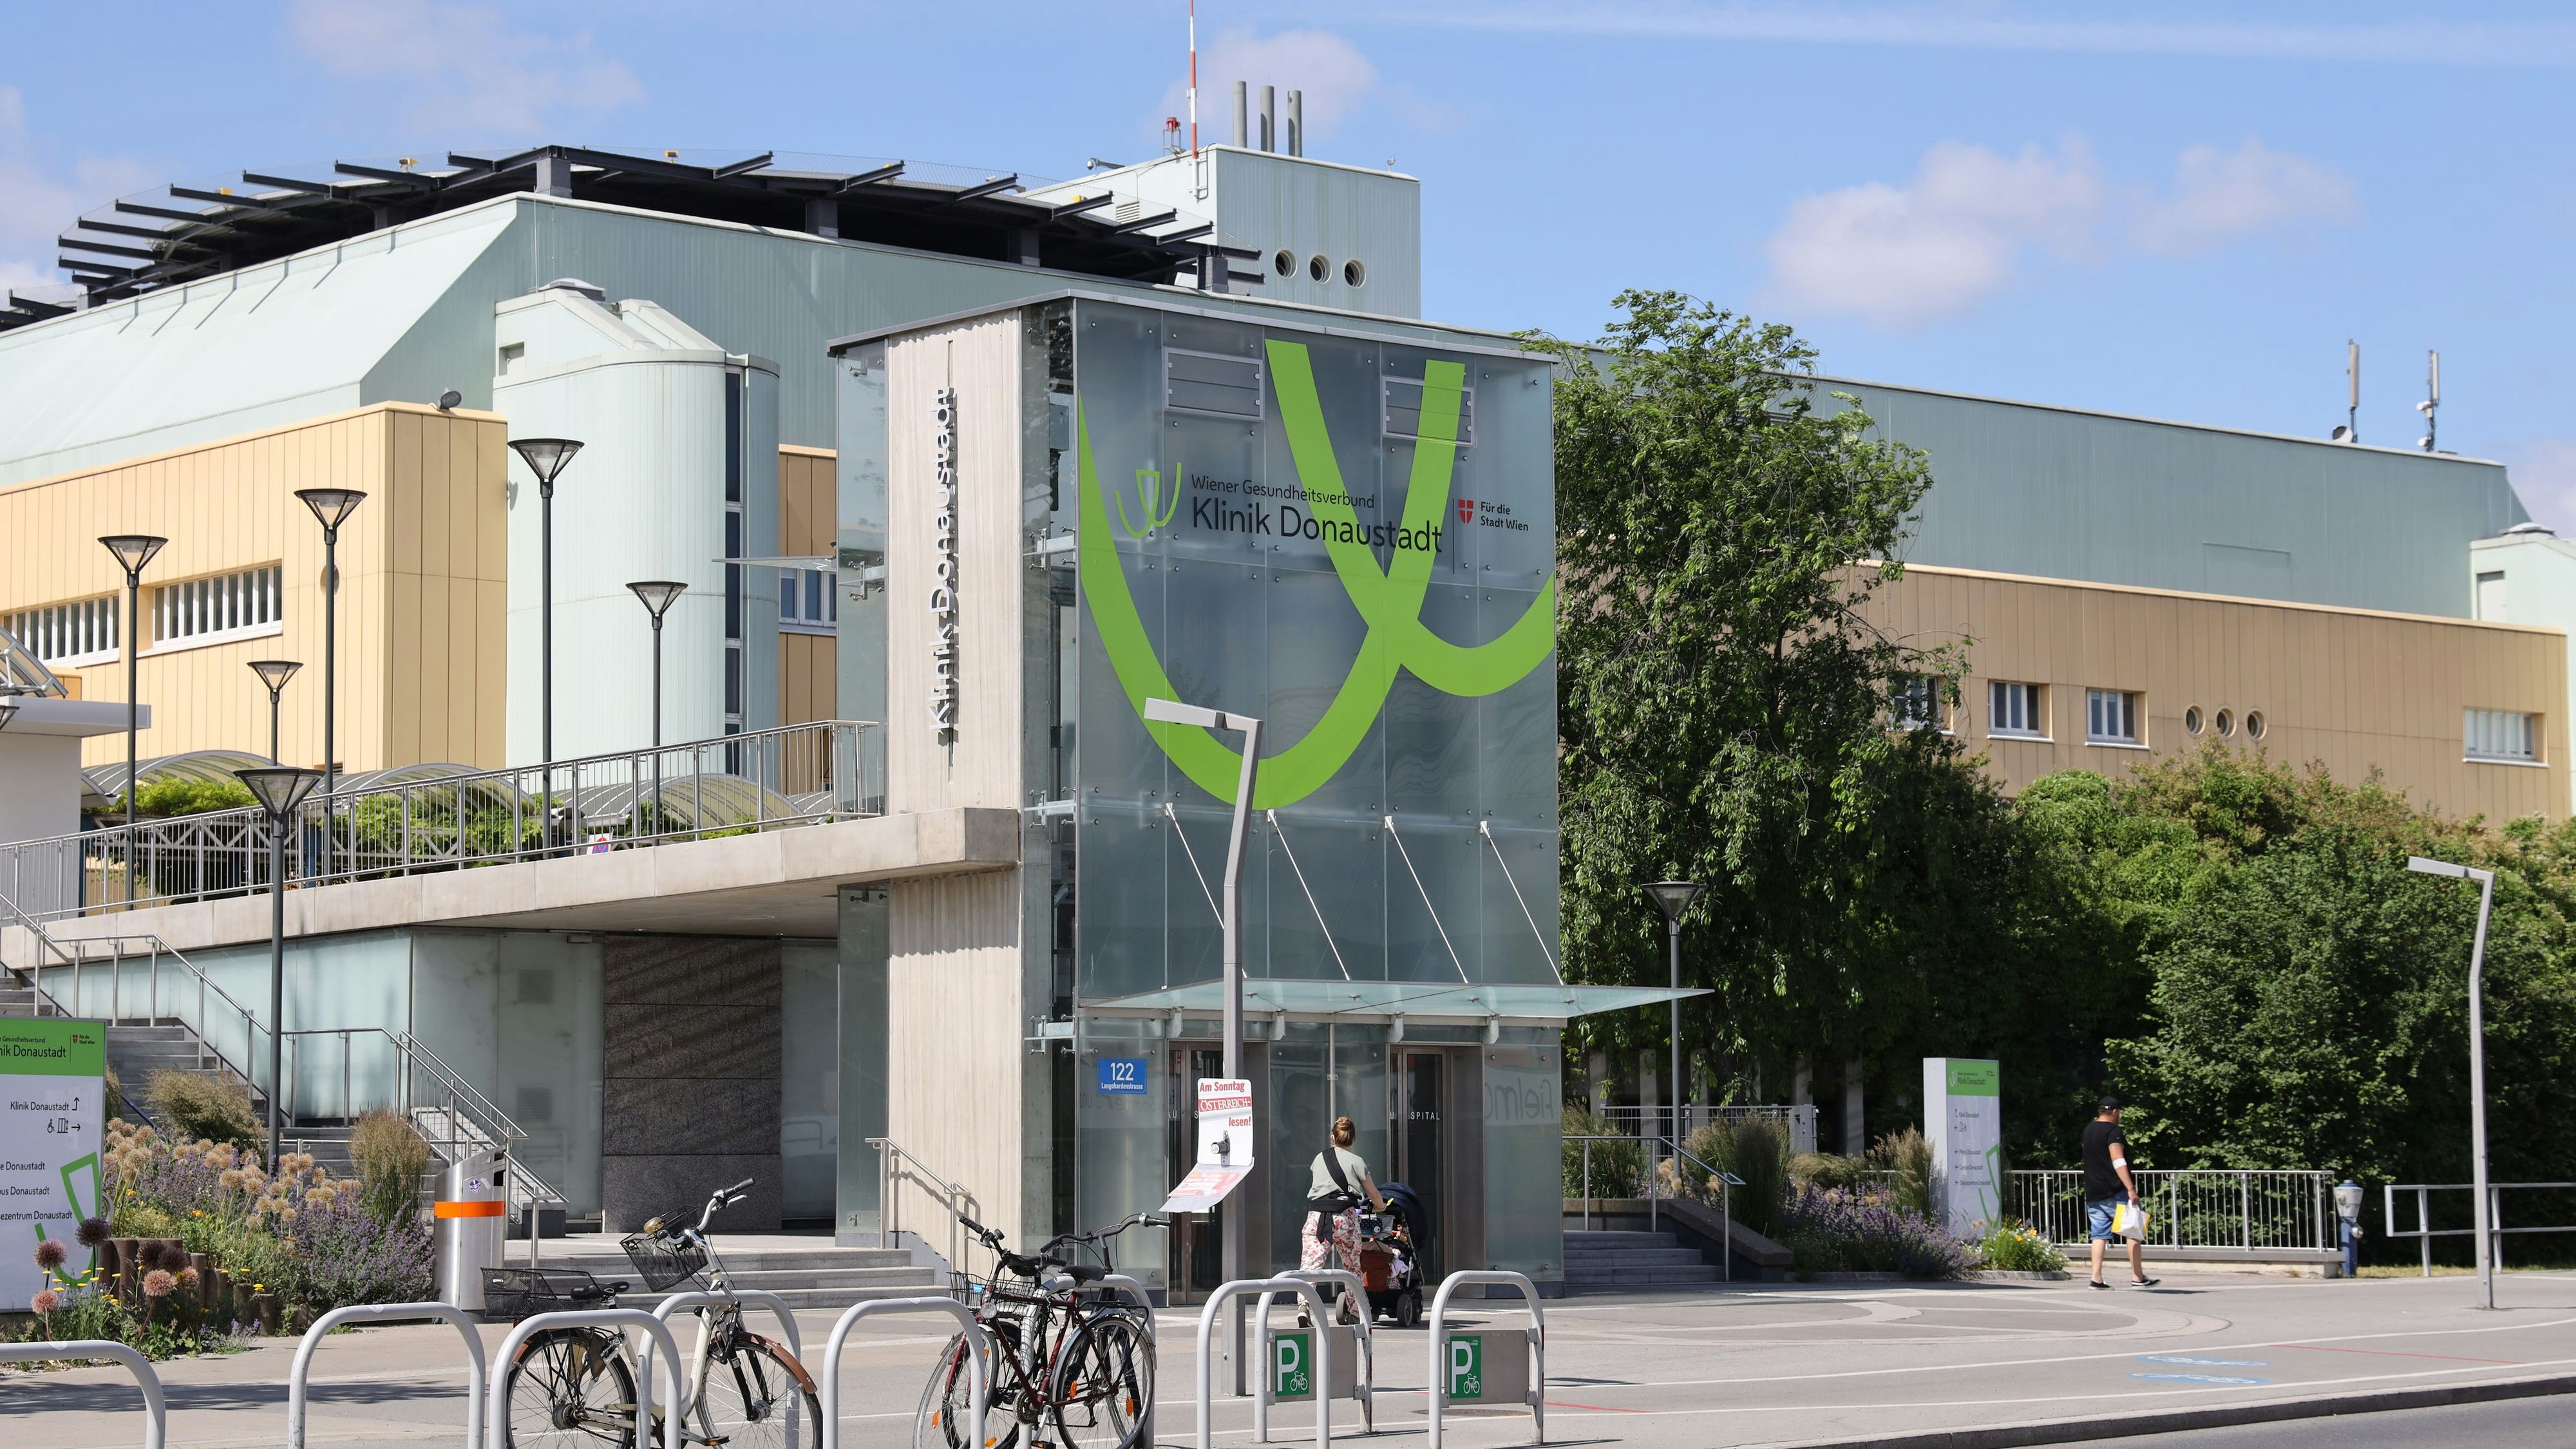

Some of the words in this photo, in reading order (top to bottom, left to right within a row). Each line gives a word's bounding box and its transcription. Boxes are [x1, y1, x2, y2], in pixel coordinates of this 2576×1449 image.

[1191, 473, 1238, 494] Wiener
[1242, 478, 1375, 509] Gesundheitsverbund
[929, 386, 955, 614] Donaustadt
[1481, 500, 1495, 514] Für
[1497, 503, 1511, 515] die
[1193, 497, 1271, 535] Klinik
[1280, 505, 1443, 553] Donaustadt
[1481, 515, 1504, 529] Stadt
[1506, 519, 1529, 532] Wien
[928, 623, 954, 732] Klinik
[14, 1045, 66, 1058] Donaustadt
[1110, 1062, 1134, 1081] 122
[1101, 1082, 1144, 1091] Langobardenstrasse
[1200, 1082, 1212, 1092] Am
[1214, 1081, 1245, 1093] Sonntag
[10, 1101, 29, 1110] Klinik
[30, 1101, 69, 1111] Donaustadt
[1200, 1097, 1252, 1112] ÖSTERREICH-
[1229, 1117, 1251, 1127] lesen!
[6, 1161, 45, 1171] Donaustadt
[10, 1186, 50, 1195] Donaustadt
[33, 1210, 73, 1220] Donaustadt
[1276, 1339, 1300, 1392] P
[1451, 1340, 1473, 1394] P
